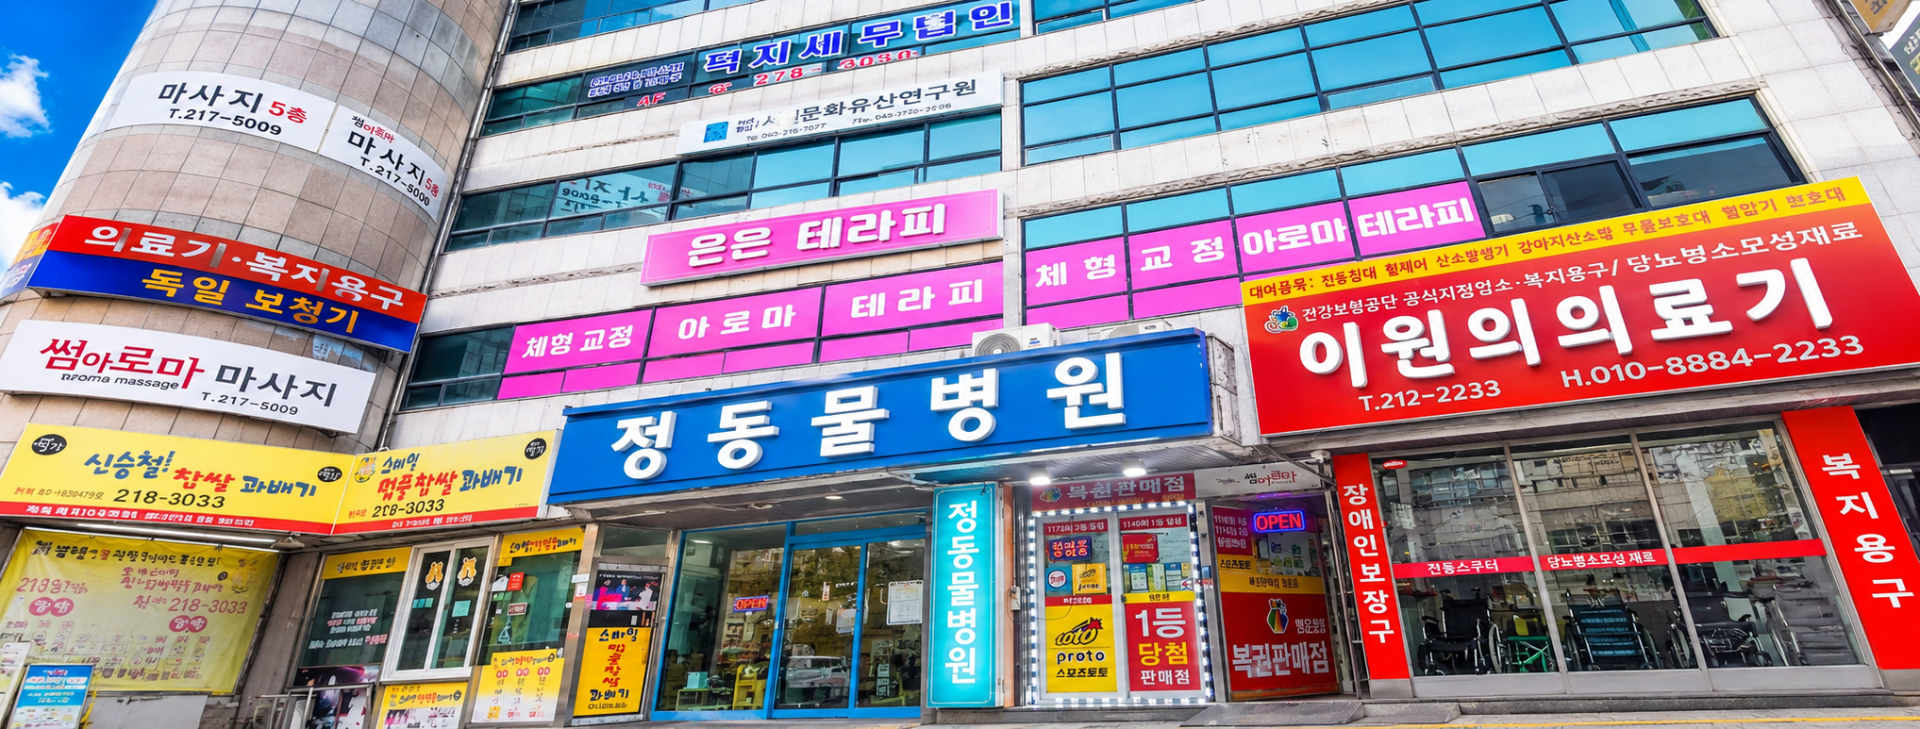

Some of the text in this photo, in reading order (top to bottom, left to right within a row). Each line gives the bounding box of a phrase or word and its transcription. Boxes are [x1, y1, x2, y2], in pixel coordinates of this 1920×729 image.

[158, 82, 308, 124] 마사지 5층
[169, 108, 282, 136] T.217-5009
[347, 131, 426, 186] 마사지
[687, 202, 946, 267] 은은 테라피
[1035, 197, 1475, 288] 체형 교정 아로마 테라피
[141, 268, 360, 334] 독일 보청기
[521, 278, 984, 359] 체형 교정 아로마 테라피
[40, 338, 338, 408] 썸아로마 마사지
[114, 376, 180, 391] massage
[1358, 335, 1864, 412] T.212-2233 H.010-8884-2233
[201, 391, 299, 416] T.217-5009
[610, 351, 1127, 481] 정동물병원
[113, 488, 226, 510] 218-3033
[173, 467, 236, 493] 찹쌀
[1255, 512, 1303, 531] OPEN
[1821, 452, 1915, 609] 복지용구
[1343, 483, 1395, 644] 장애인보장구
[735, 596, 769, 611] OPEN
[944, 500, 980, 684] 정동물병원
[1135, 607, 1186, 639] 1등
[1057, 650, 1106, 665] proto
[1138, 641, 1189, 667] 당첨
[1141, 669, 1190, 686] 판매점
